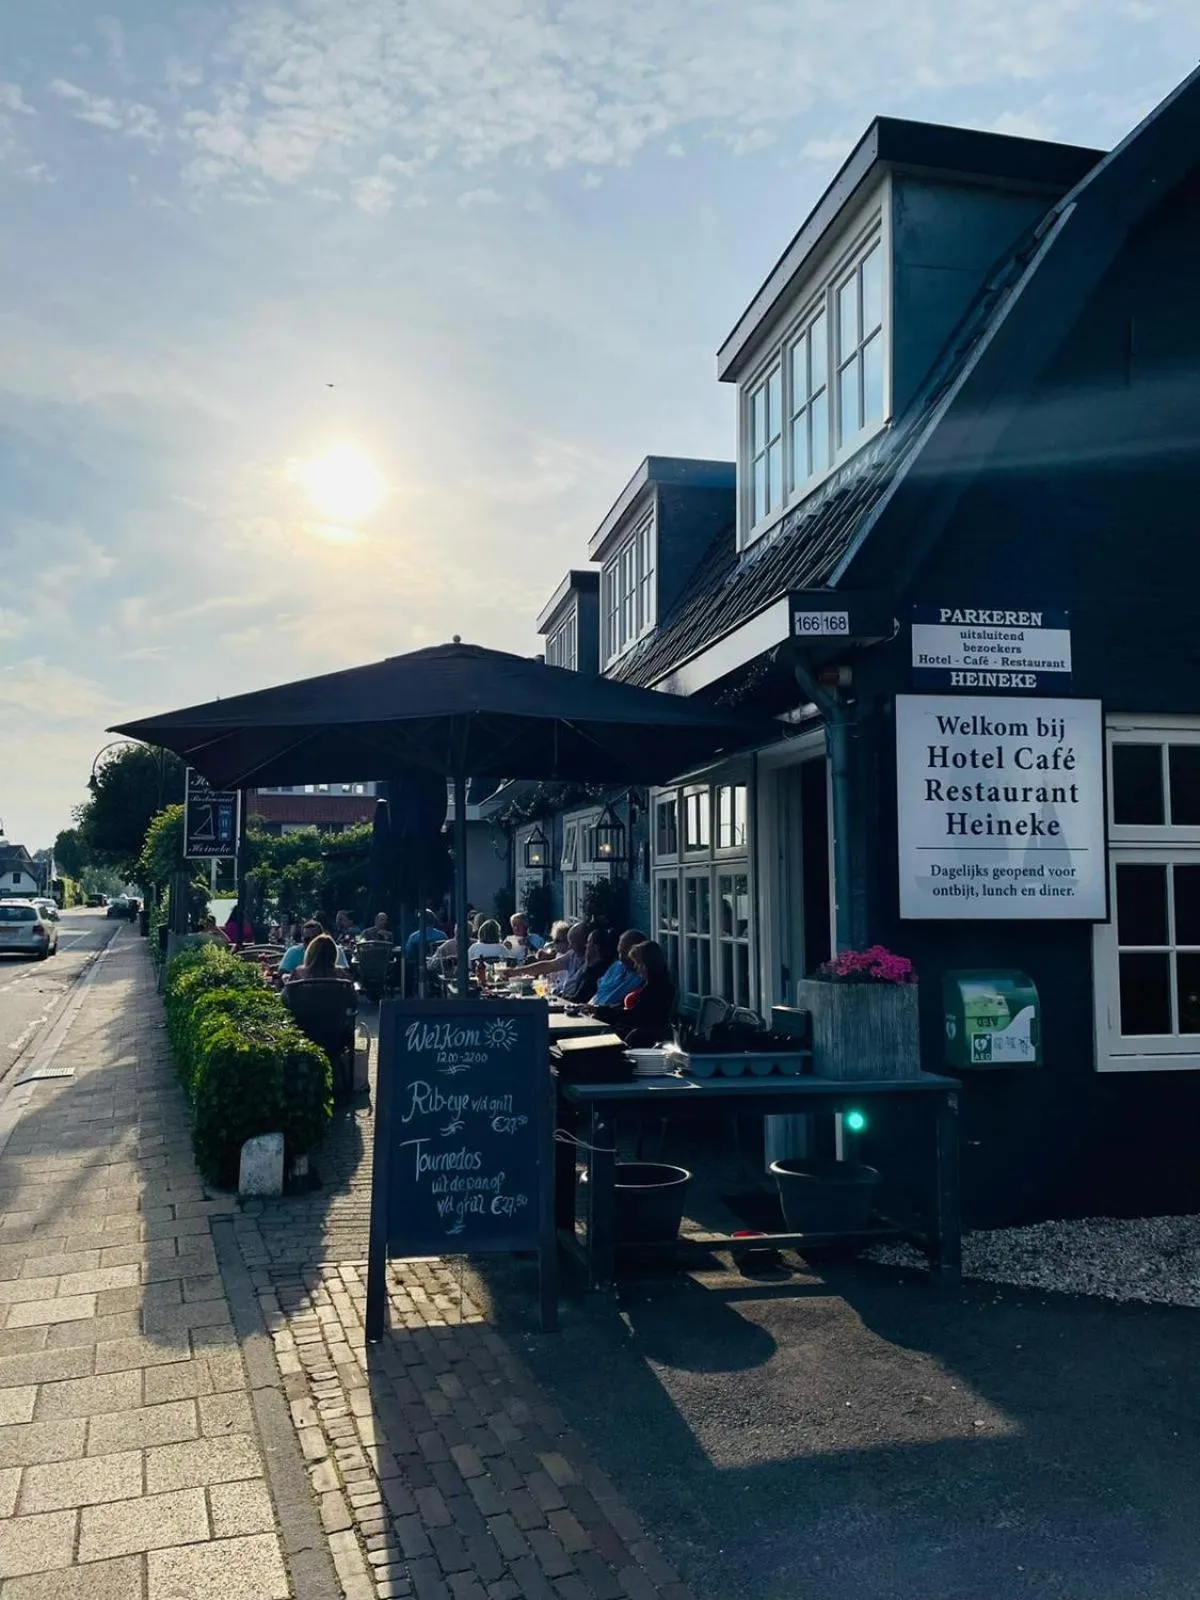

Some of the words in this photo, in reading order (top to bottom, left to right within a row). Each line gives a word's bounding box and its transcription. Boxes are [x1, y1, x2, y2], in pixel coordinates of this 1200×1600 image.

[796, 616, 820, 631] 166
[823, 616, 847, 631] 168
[939, 608, 1043, 626] PARKEREN
[960, 630, 1025, 642] uitsluitend
[963, 642, 1022, 654] bezoekers
[919, 654, 952, 665] Hotel
[963, 654, 989, 666] Café
[1001, 657, 1065, 669] Restaurant
[950, 671, 1038, 689] HEINEKE
[936, 715, 1029, 737] Welkom
[1036, 716, 1066, 744] bij
[927, 745, 1005, 769] Hotel
[1014, 746, 1076, 770] Café
[924, 778, 1080, 803] Restaurant
[946, 812, 1060, 836] Heineke
[930, 864, 989, 880] Dagelijks
[992, 865, 1045, 880] geopend
[1048, 867, 1077, 878] voor
[932, 883, 980, 900] ontbijt,
[982, 884, 1018, 896] lunch
[1021, 887, 1036, 896] en
[1039, 884, 1076, 897] diner.
[400, 1138, 482, 1182] Tournedos
